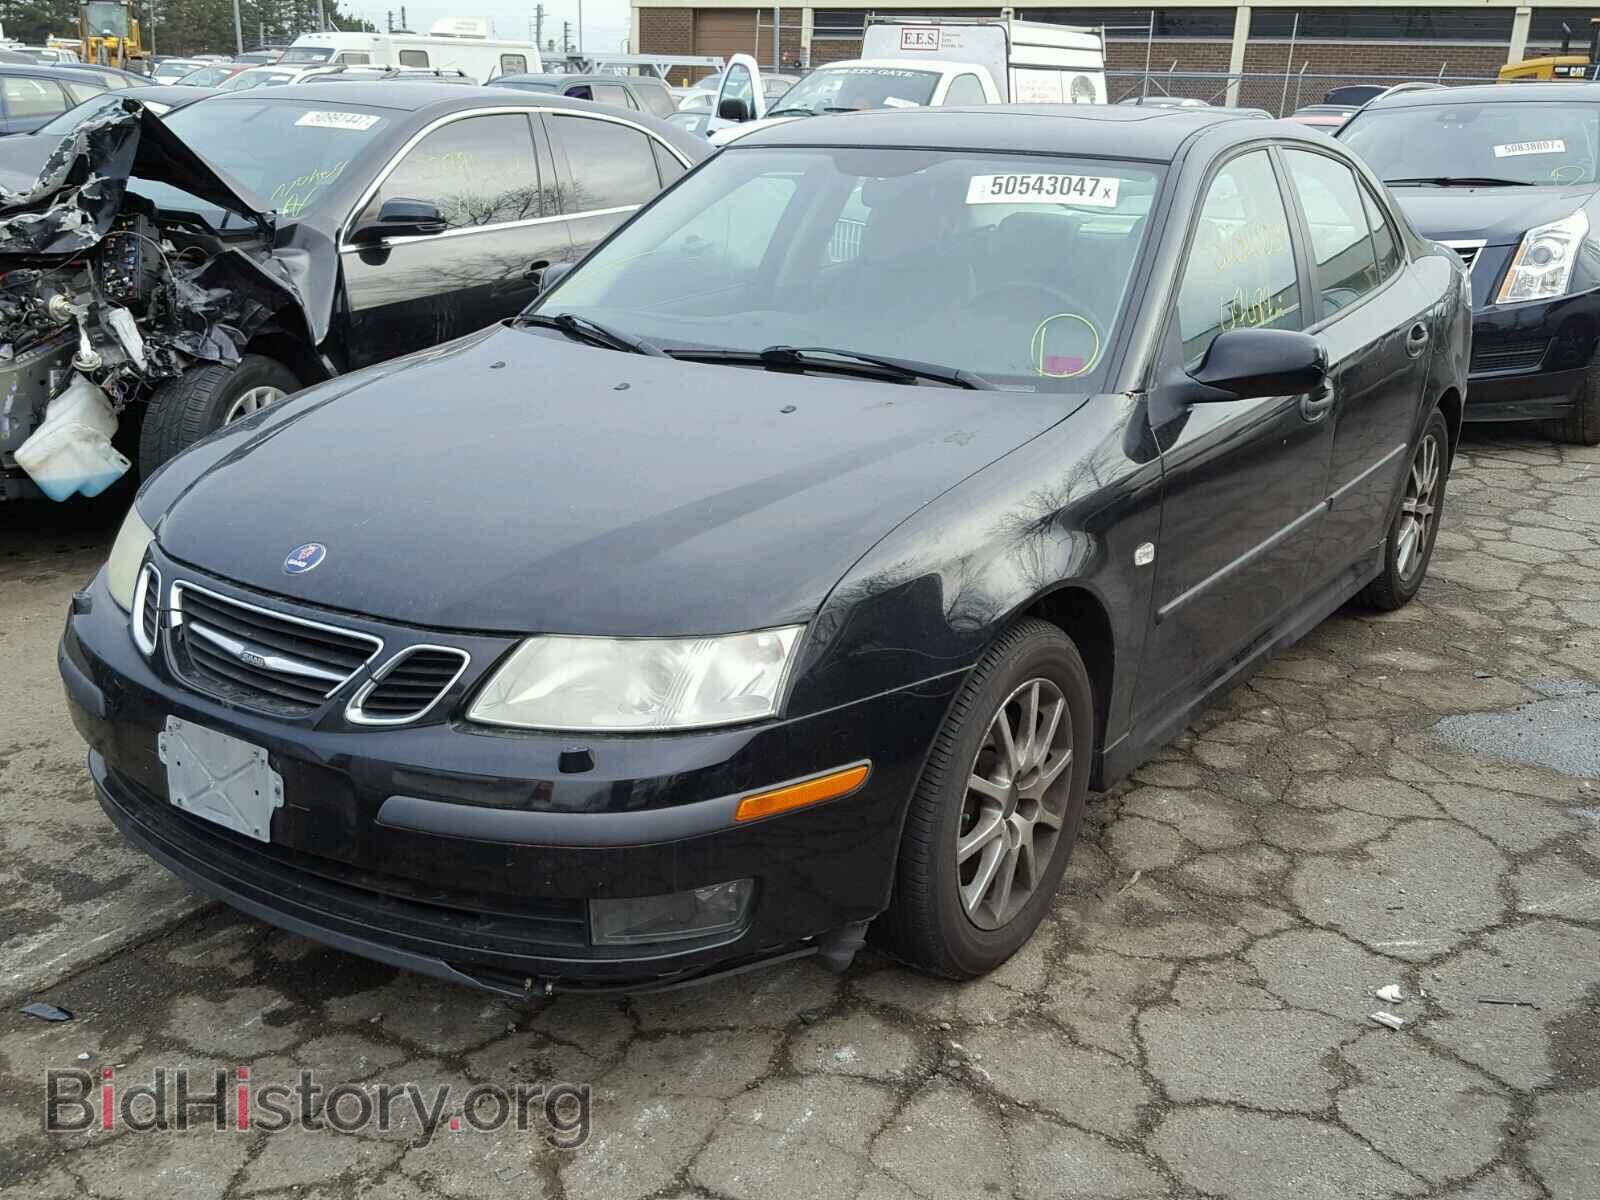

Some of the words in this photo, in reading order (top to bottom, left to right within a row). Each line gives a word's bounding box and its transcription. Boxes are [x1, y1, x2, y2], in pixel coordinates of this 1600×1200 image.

[903, 32, 937, 45] E.E.S.
[1570, 67, 1586, 77] CAT
[990, 175, 1100, 197] 50543047
